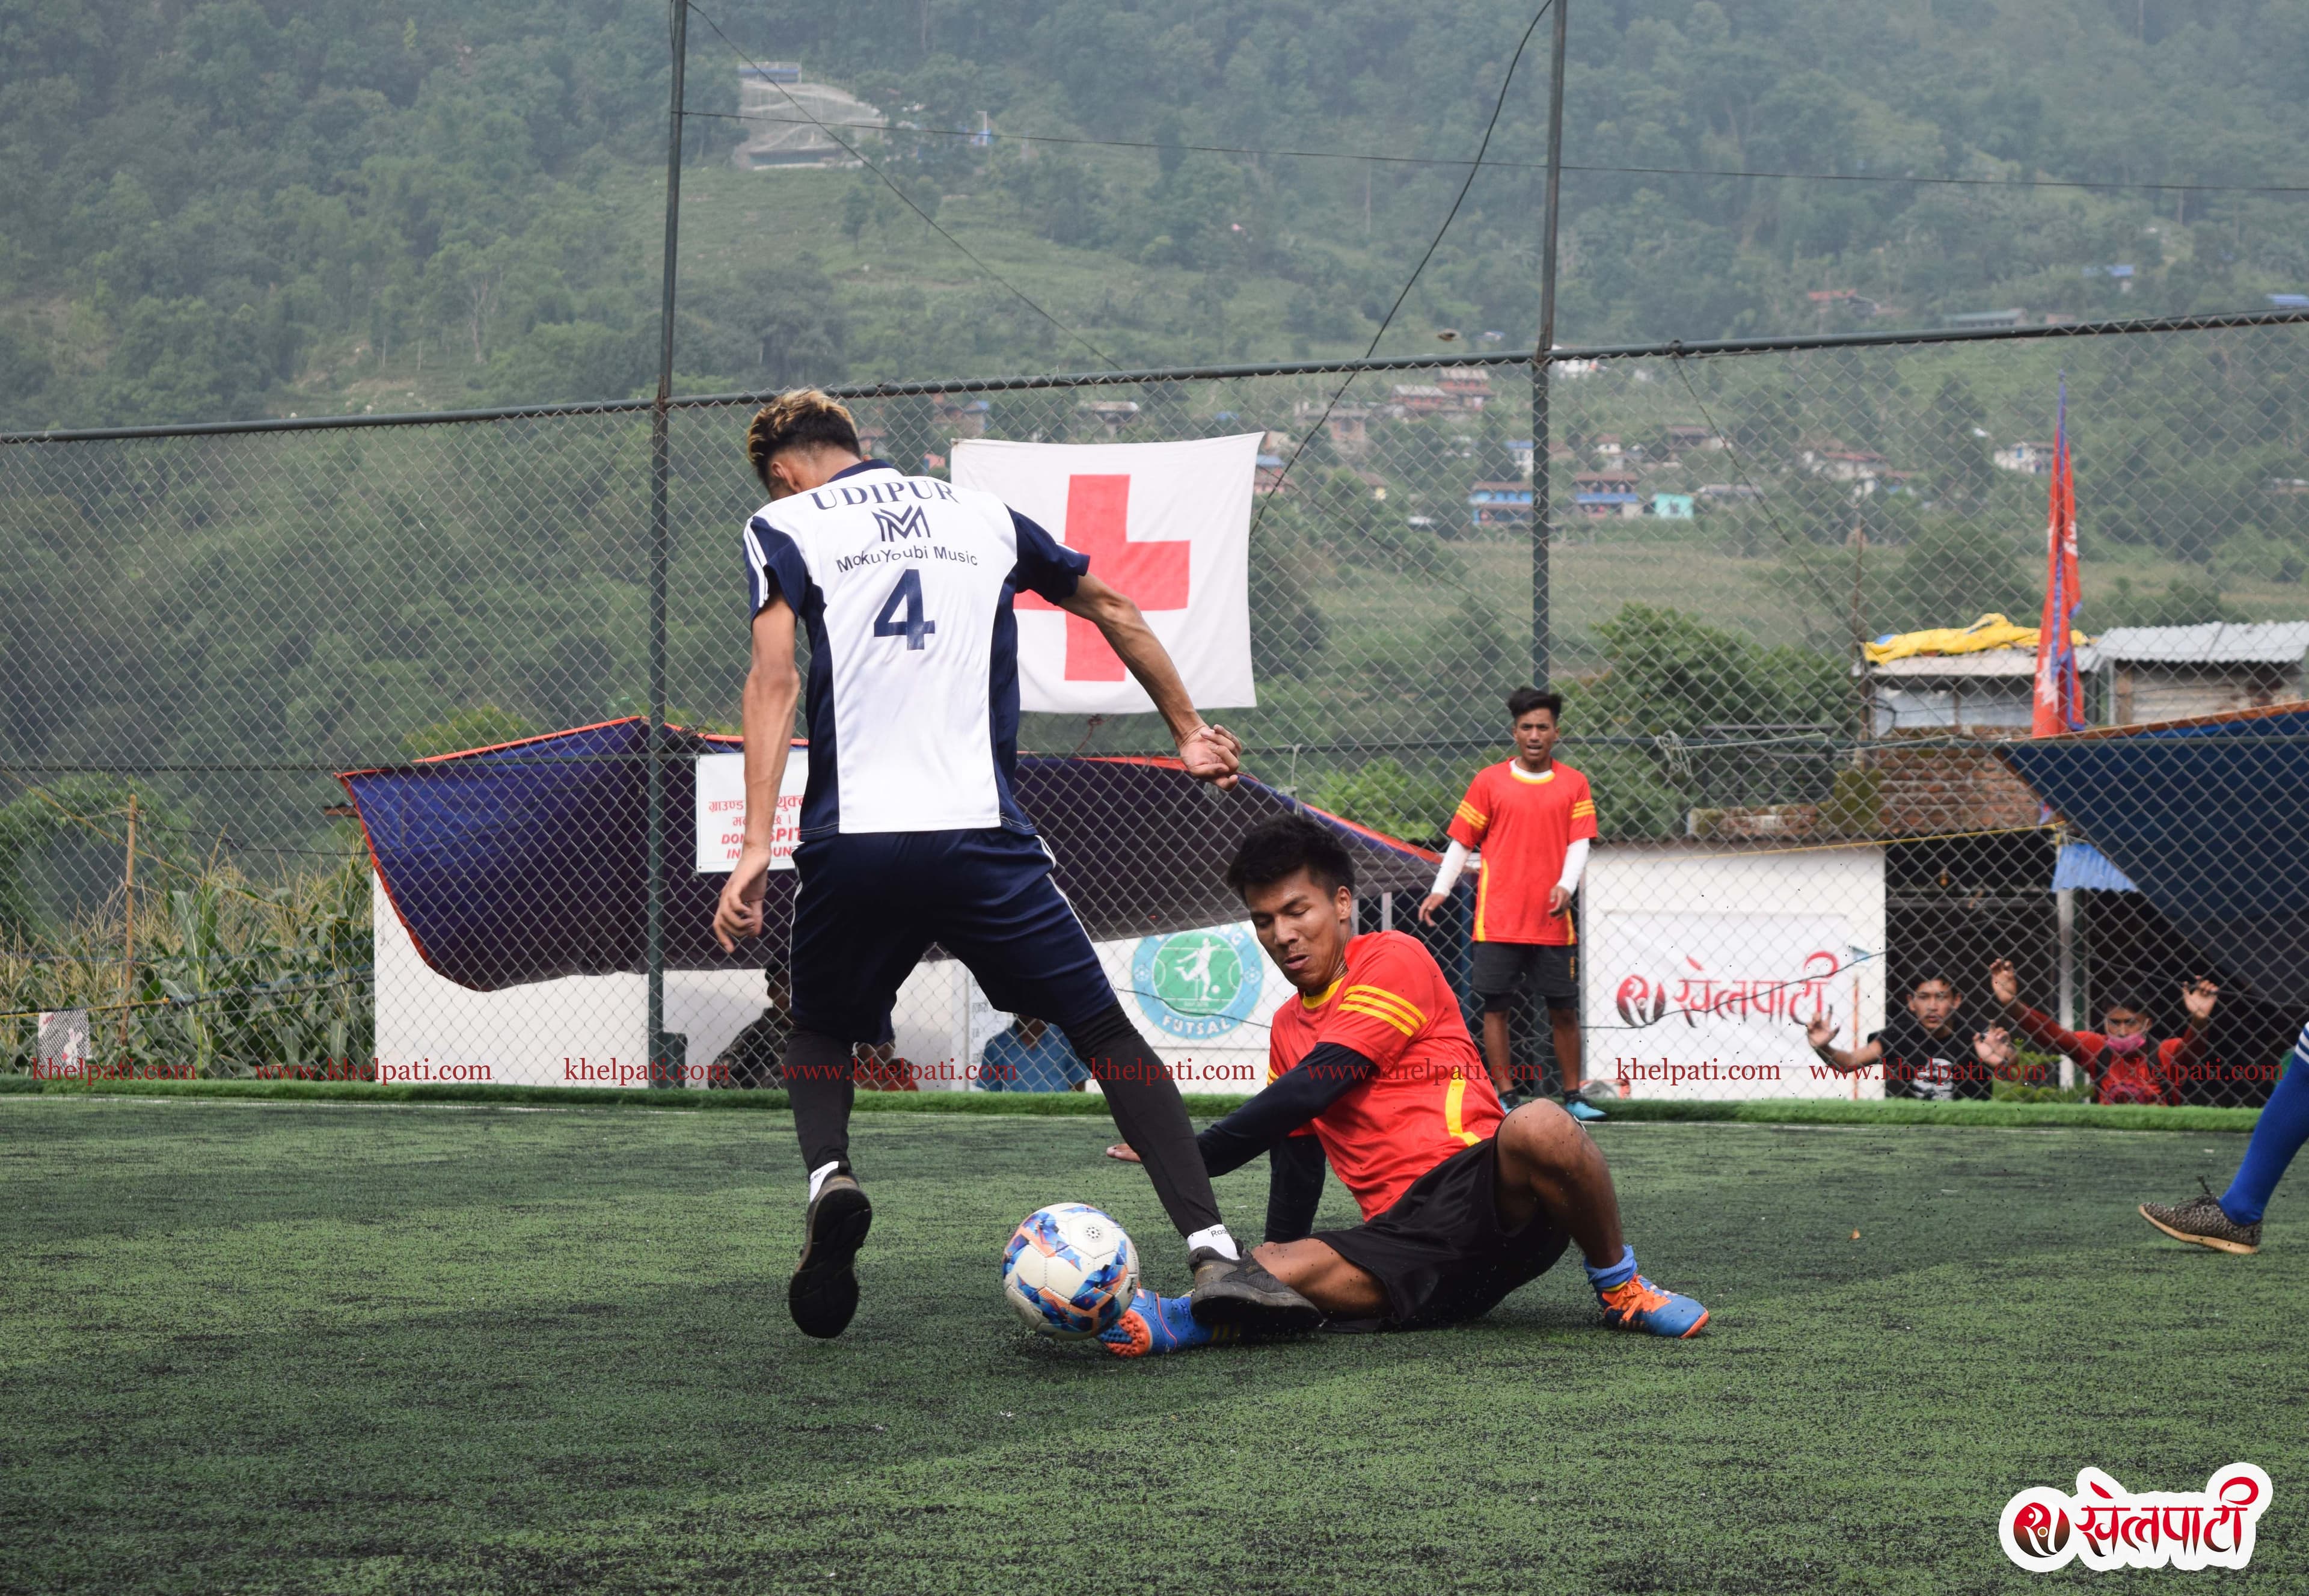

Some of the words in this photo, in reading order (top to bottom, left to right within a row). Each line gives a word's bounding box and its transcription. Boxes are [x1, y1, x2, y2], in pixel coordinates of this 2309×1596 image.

[808, 479, 960, 511] UDIPUR
[836, 545, 928, 572] MokuYoubi
[934, 545, 978, 566] Music
[873, 568, 936, 651] 4
[1162, 1014, 1231, 1036] FUTSAL
